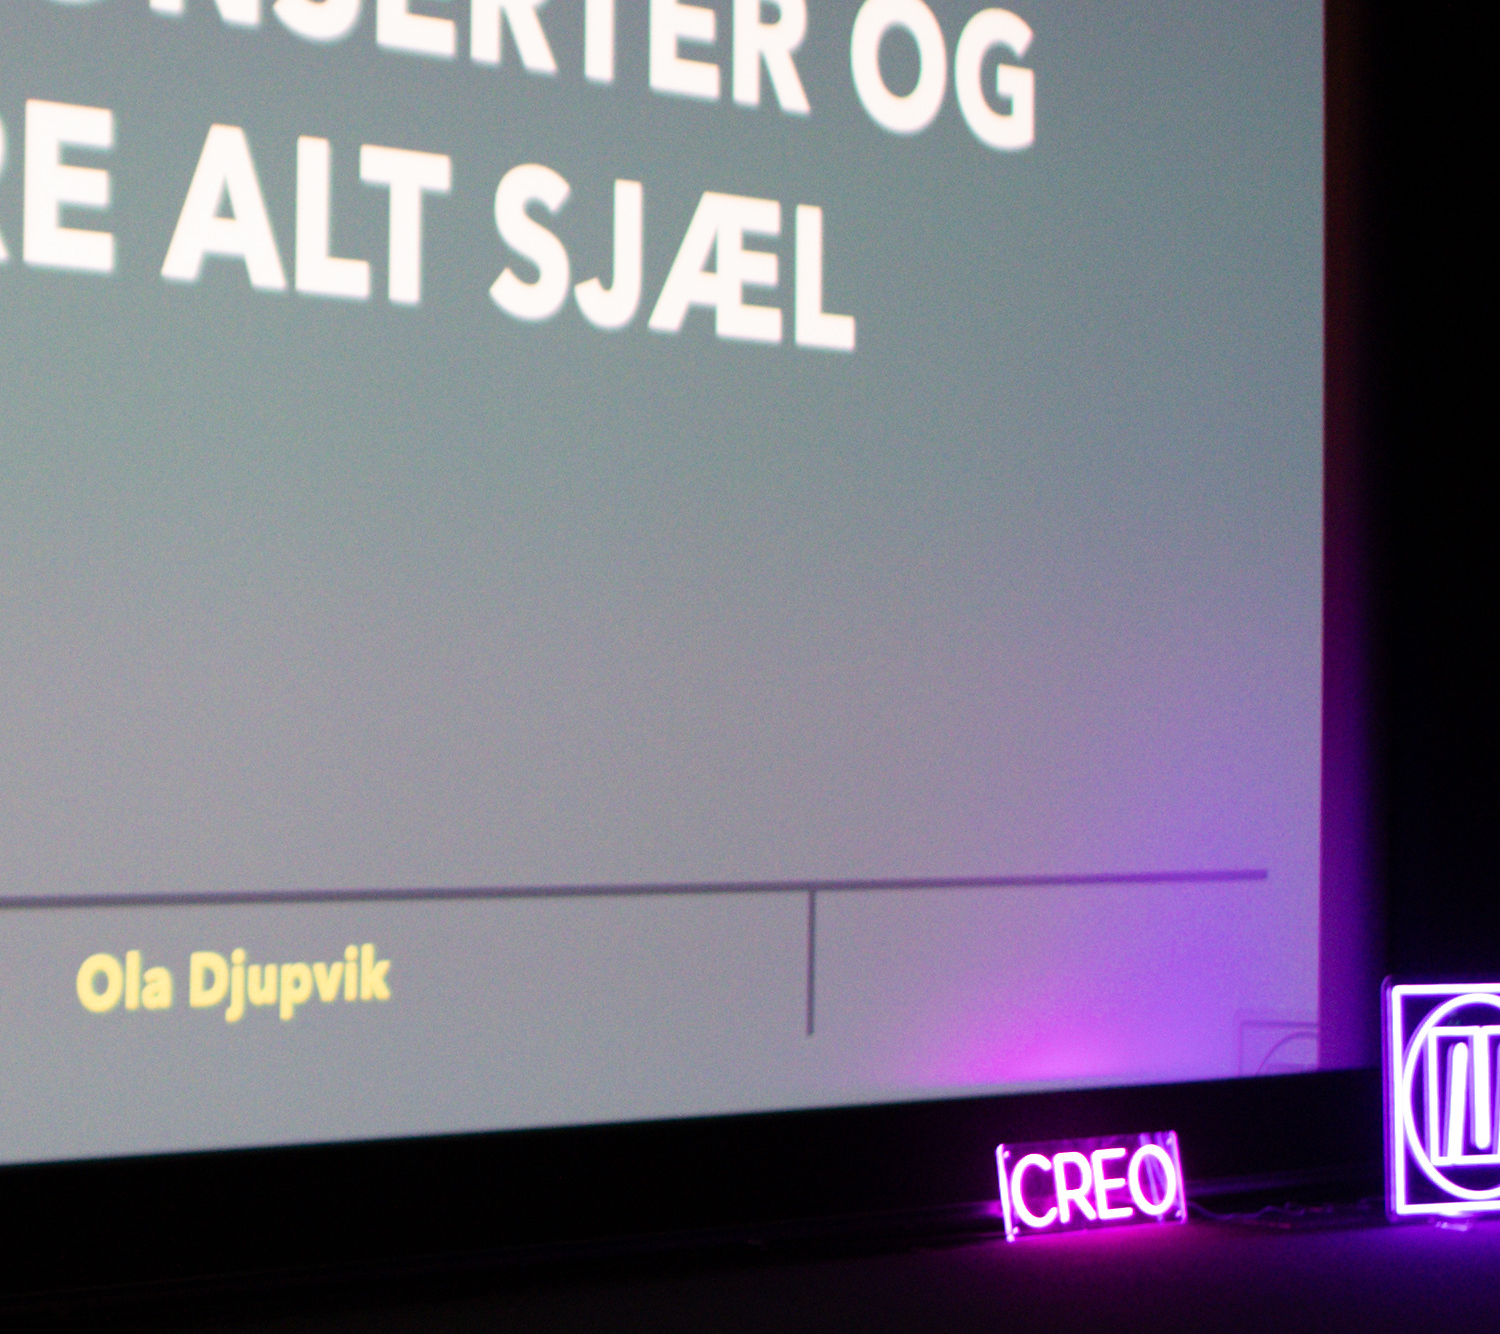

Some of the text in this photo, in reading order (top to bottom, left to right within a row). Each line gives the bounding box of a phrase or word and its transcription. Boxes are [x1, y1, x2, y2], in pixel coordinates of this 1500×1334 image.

[158, 122, 455, 308] ALT
[486, 162, 858, 354] SJÆL
[74, 942, 393, 1025] Ola Djupvik
[1010, 1142, 1178, 1229] CREO
